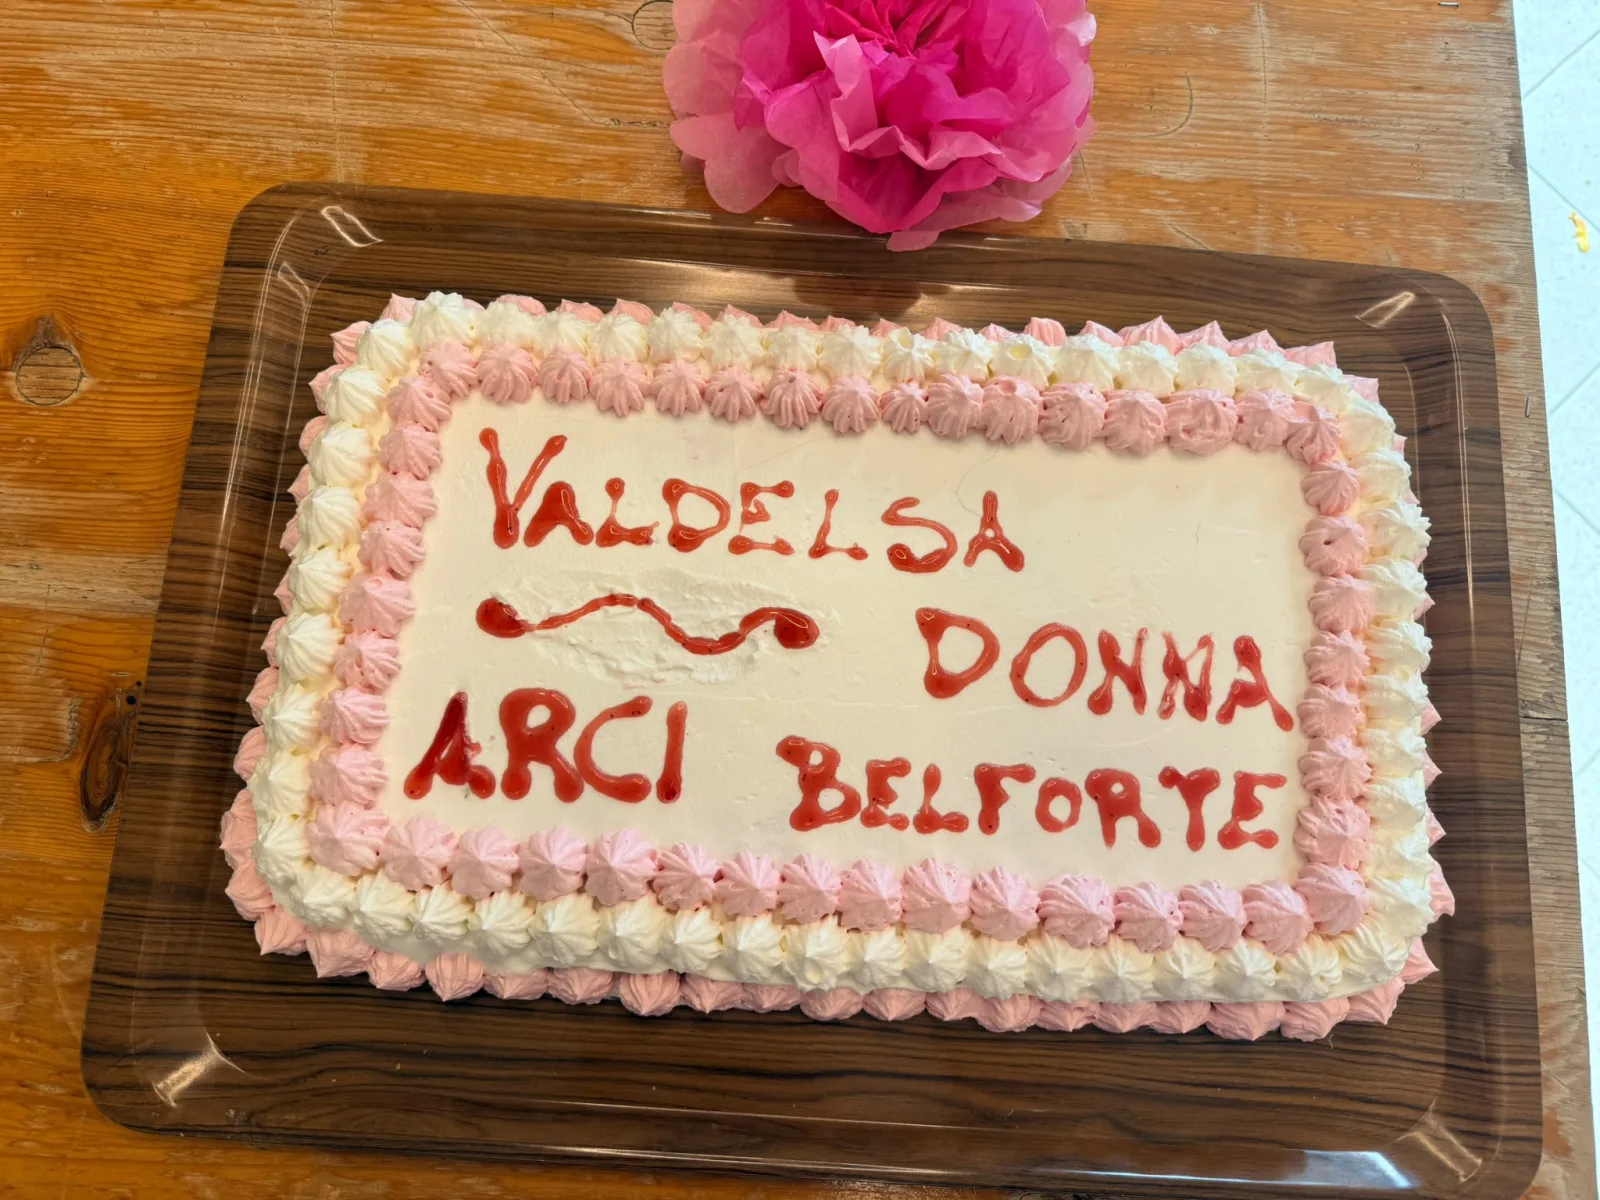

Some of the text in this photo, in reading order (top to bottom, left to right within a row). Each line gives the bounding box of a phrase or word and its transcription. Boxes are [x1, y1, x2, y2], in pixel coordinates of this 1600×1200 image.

[479, 428, 1025, 574] VALDELSA
[915, 607, 1294, 732] DONNA
[403, 688, 688, 804] ARCI
[775, 735, 1287, 851] BELFORTE
